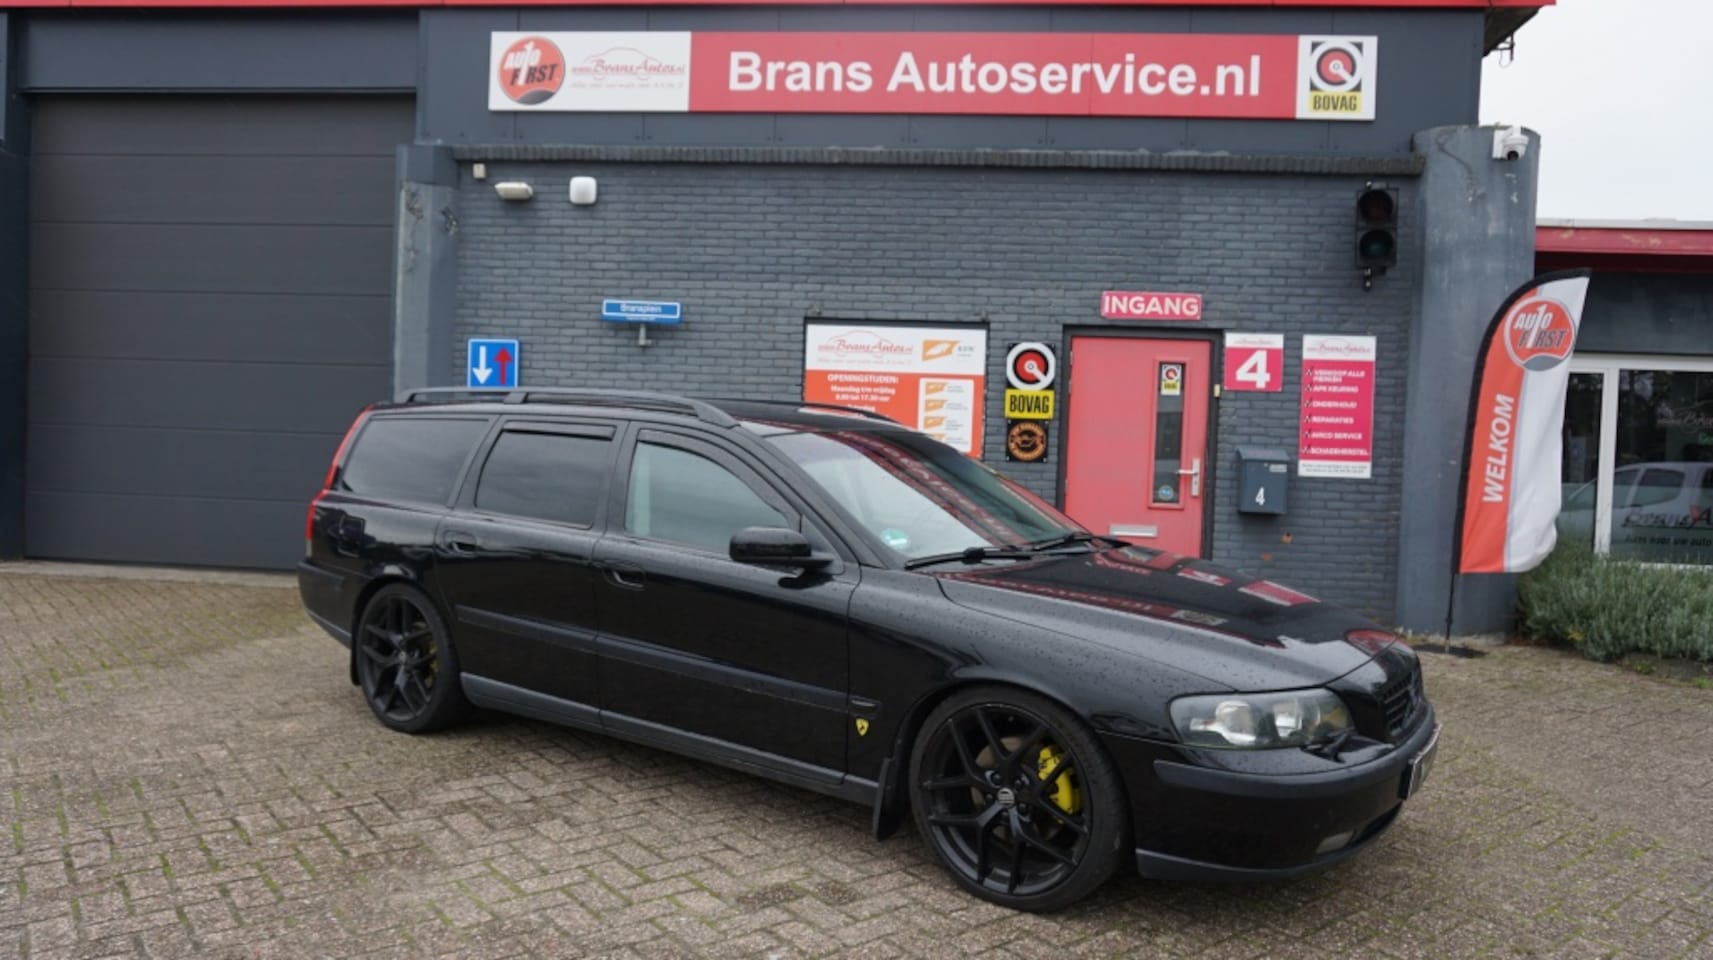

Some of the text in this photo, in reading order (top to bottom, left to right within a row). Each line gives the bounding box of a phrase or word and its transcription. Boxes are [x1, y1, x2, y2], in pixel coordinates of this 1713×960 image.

[729, 51, 1261, 96] Brans Autoservice.nl
[1313, 94, 1357, 111] BOVAG
[1104, 295, 1199, 316] INGANG
[1236, 350, 1270, 388] 4
[1009, 395, 1050, 413] BOVAG
[1482, 394, 1515, 503] WELKOM
[1255, 487, 1265, 506] 4
